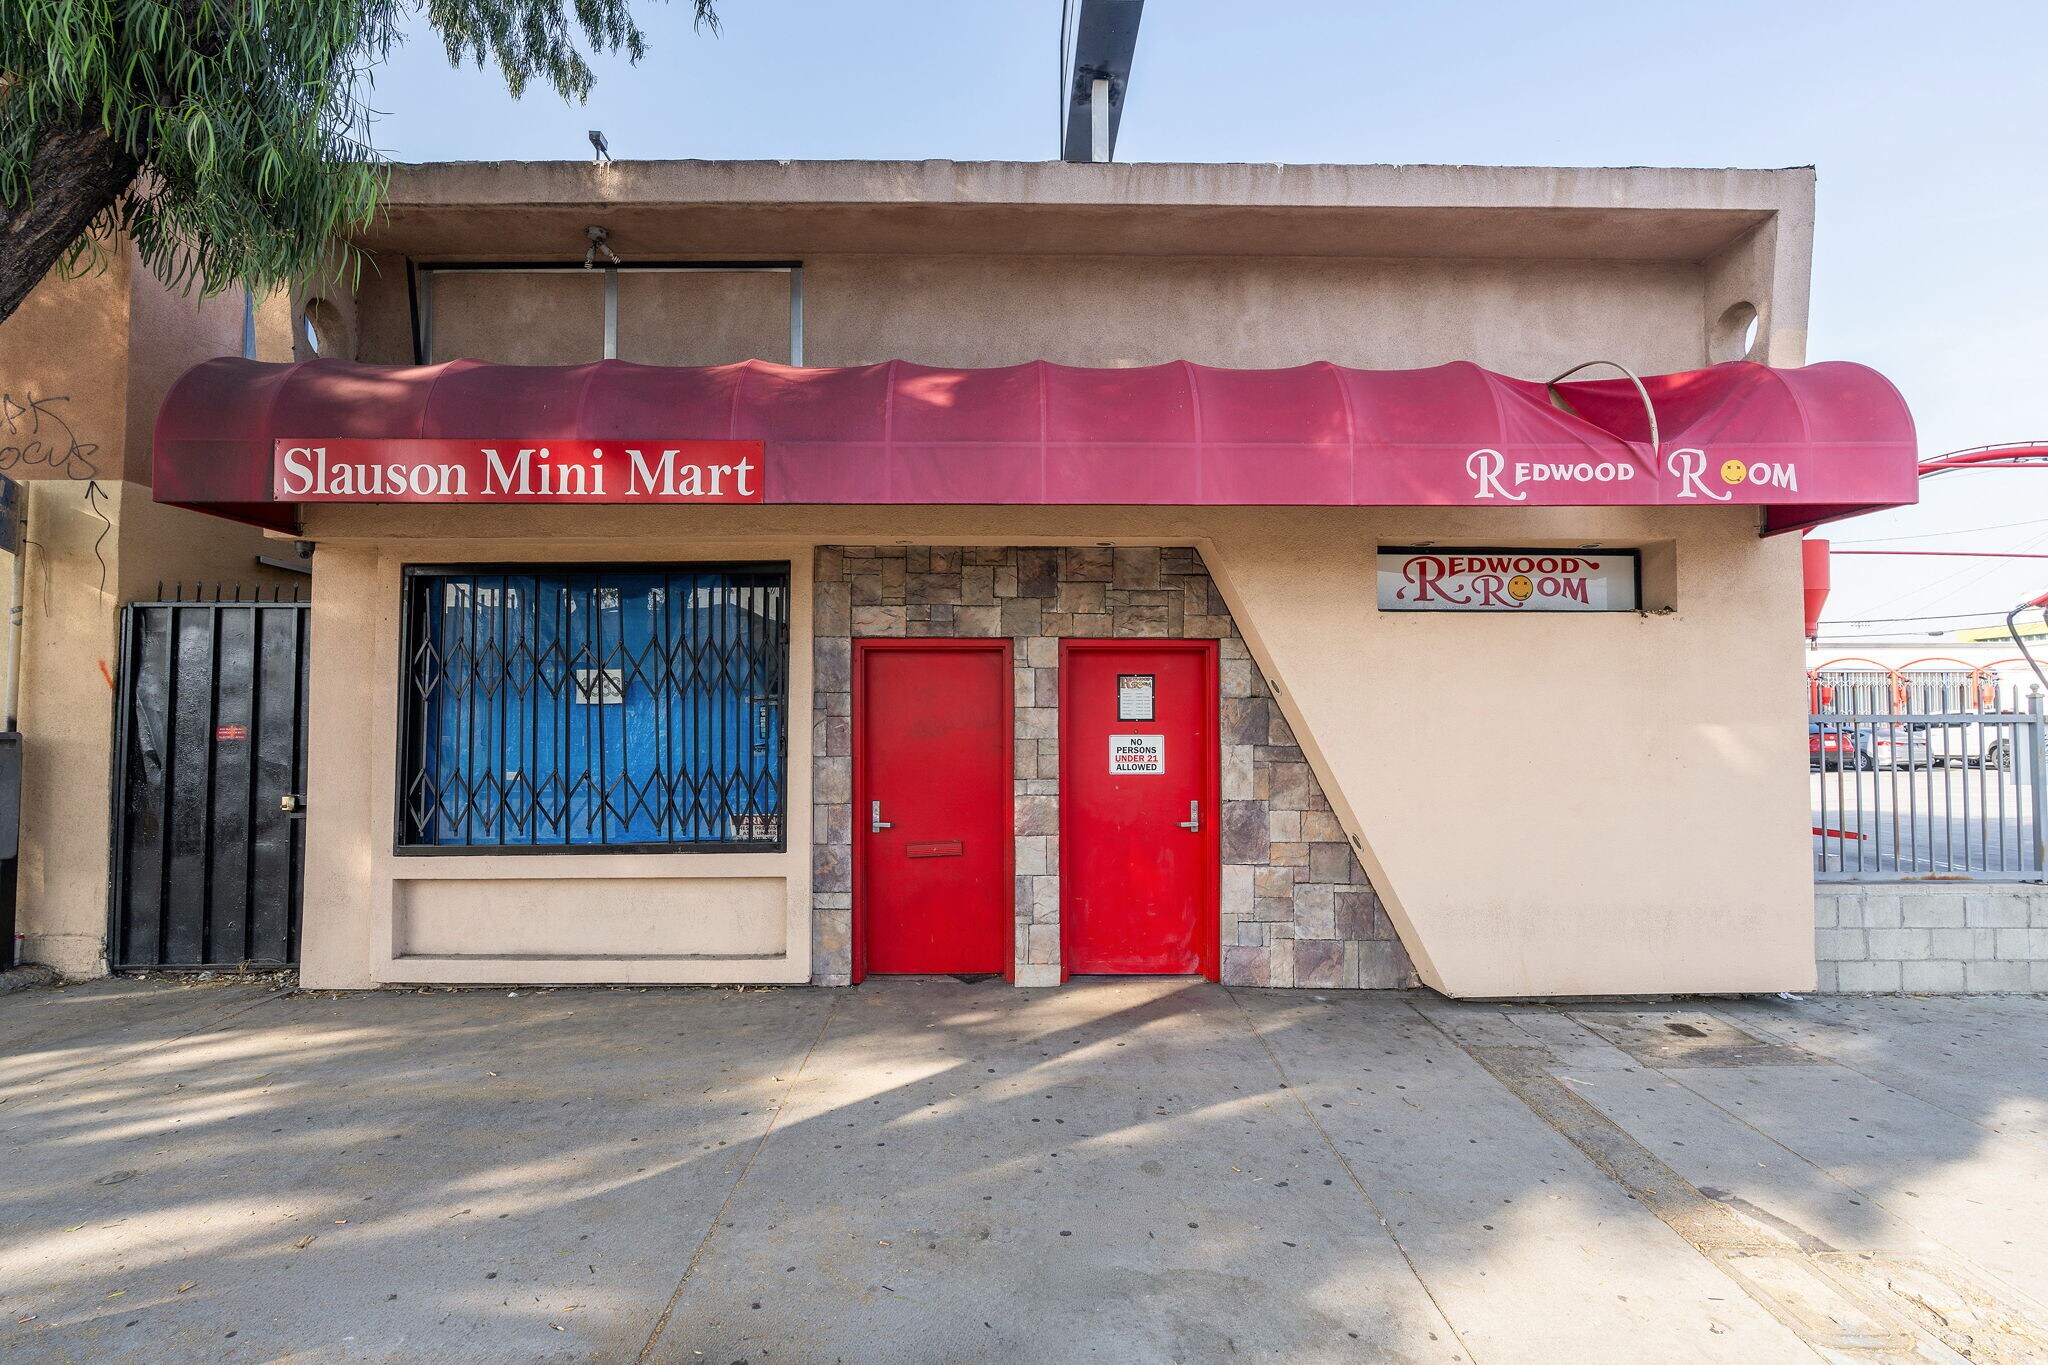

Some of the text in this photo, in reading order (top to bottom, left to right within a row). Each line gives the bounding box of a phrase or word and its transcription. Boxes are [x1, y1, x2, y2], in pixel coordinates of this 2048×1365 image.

[282, 446, 756, 497] Slauson Mini Mart
[1130, 738, 1143, 746] NO
[1116, 746, 1157, 754] PERSONS
[1116, 763, 1157, 771] ALLOWED
